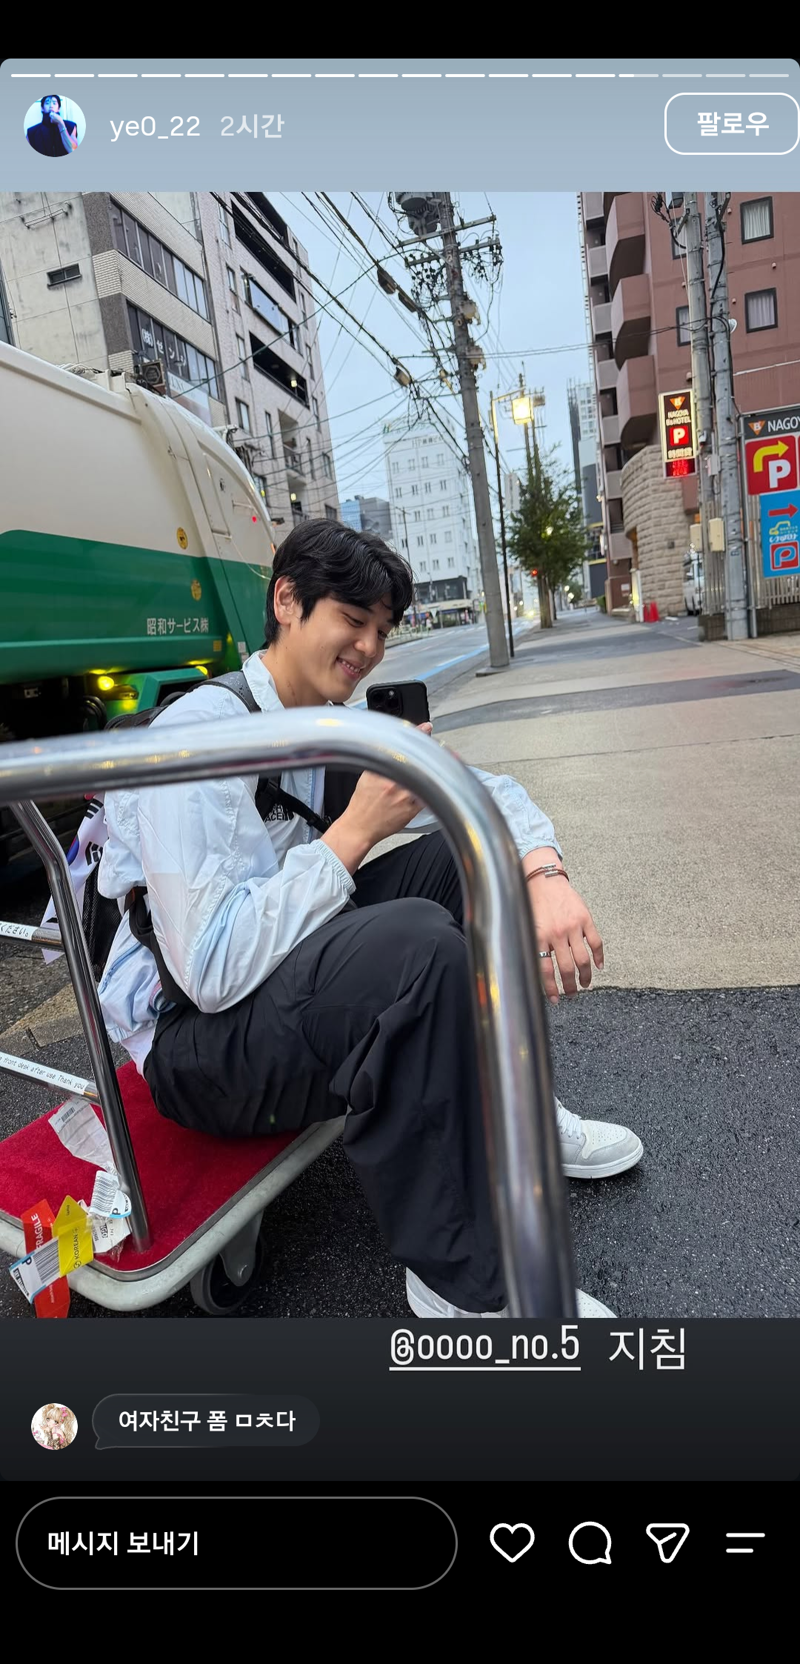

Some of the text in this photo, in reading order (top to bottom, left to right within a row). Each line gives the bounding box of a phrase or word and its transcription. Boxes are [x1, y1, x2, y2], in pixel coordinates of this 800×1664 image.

[673, 427, 686, 444] P
[768, 459, 791, 489] P
[72, 1233, 80, 1260] KOREAN
